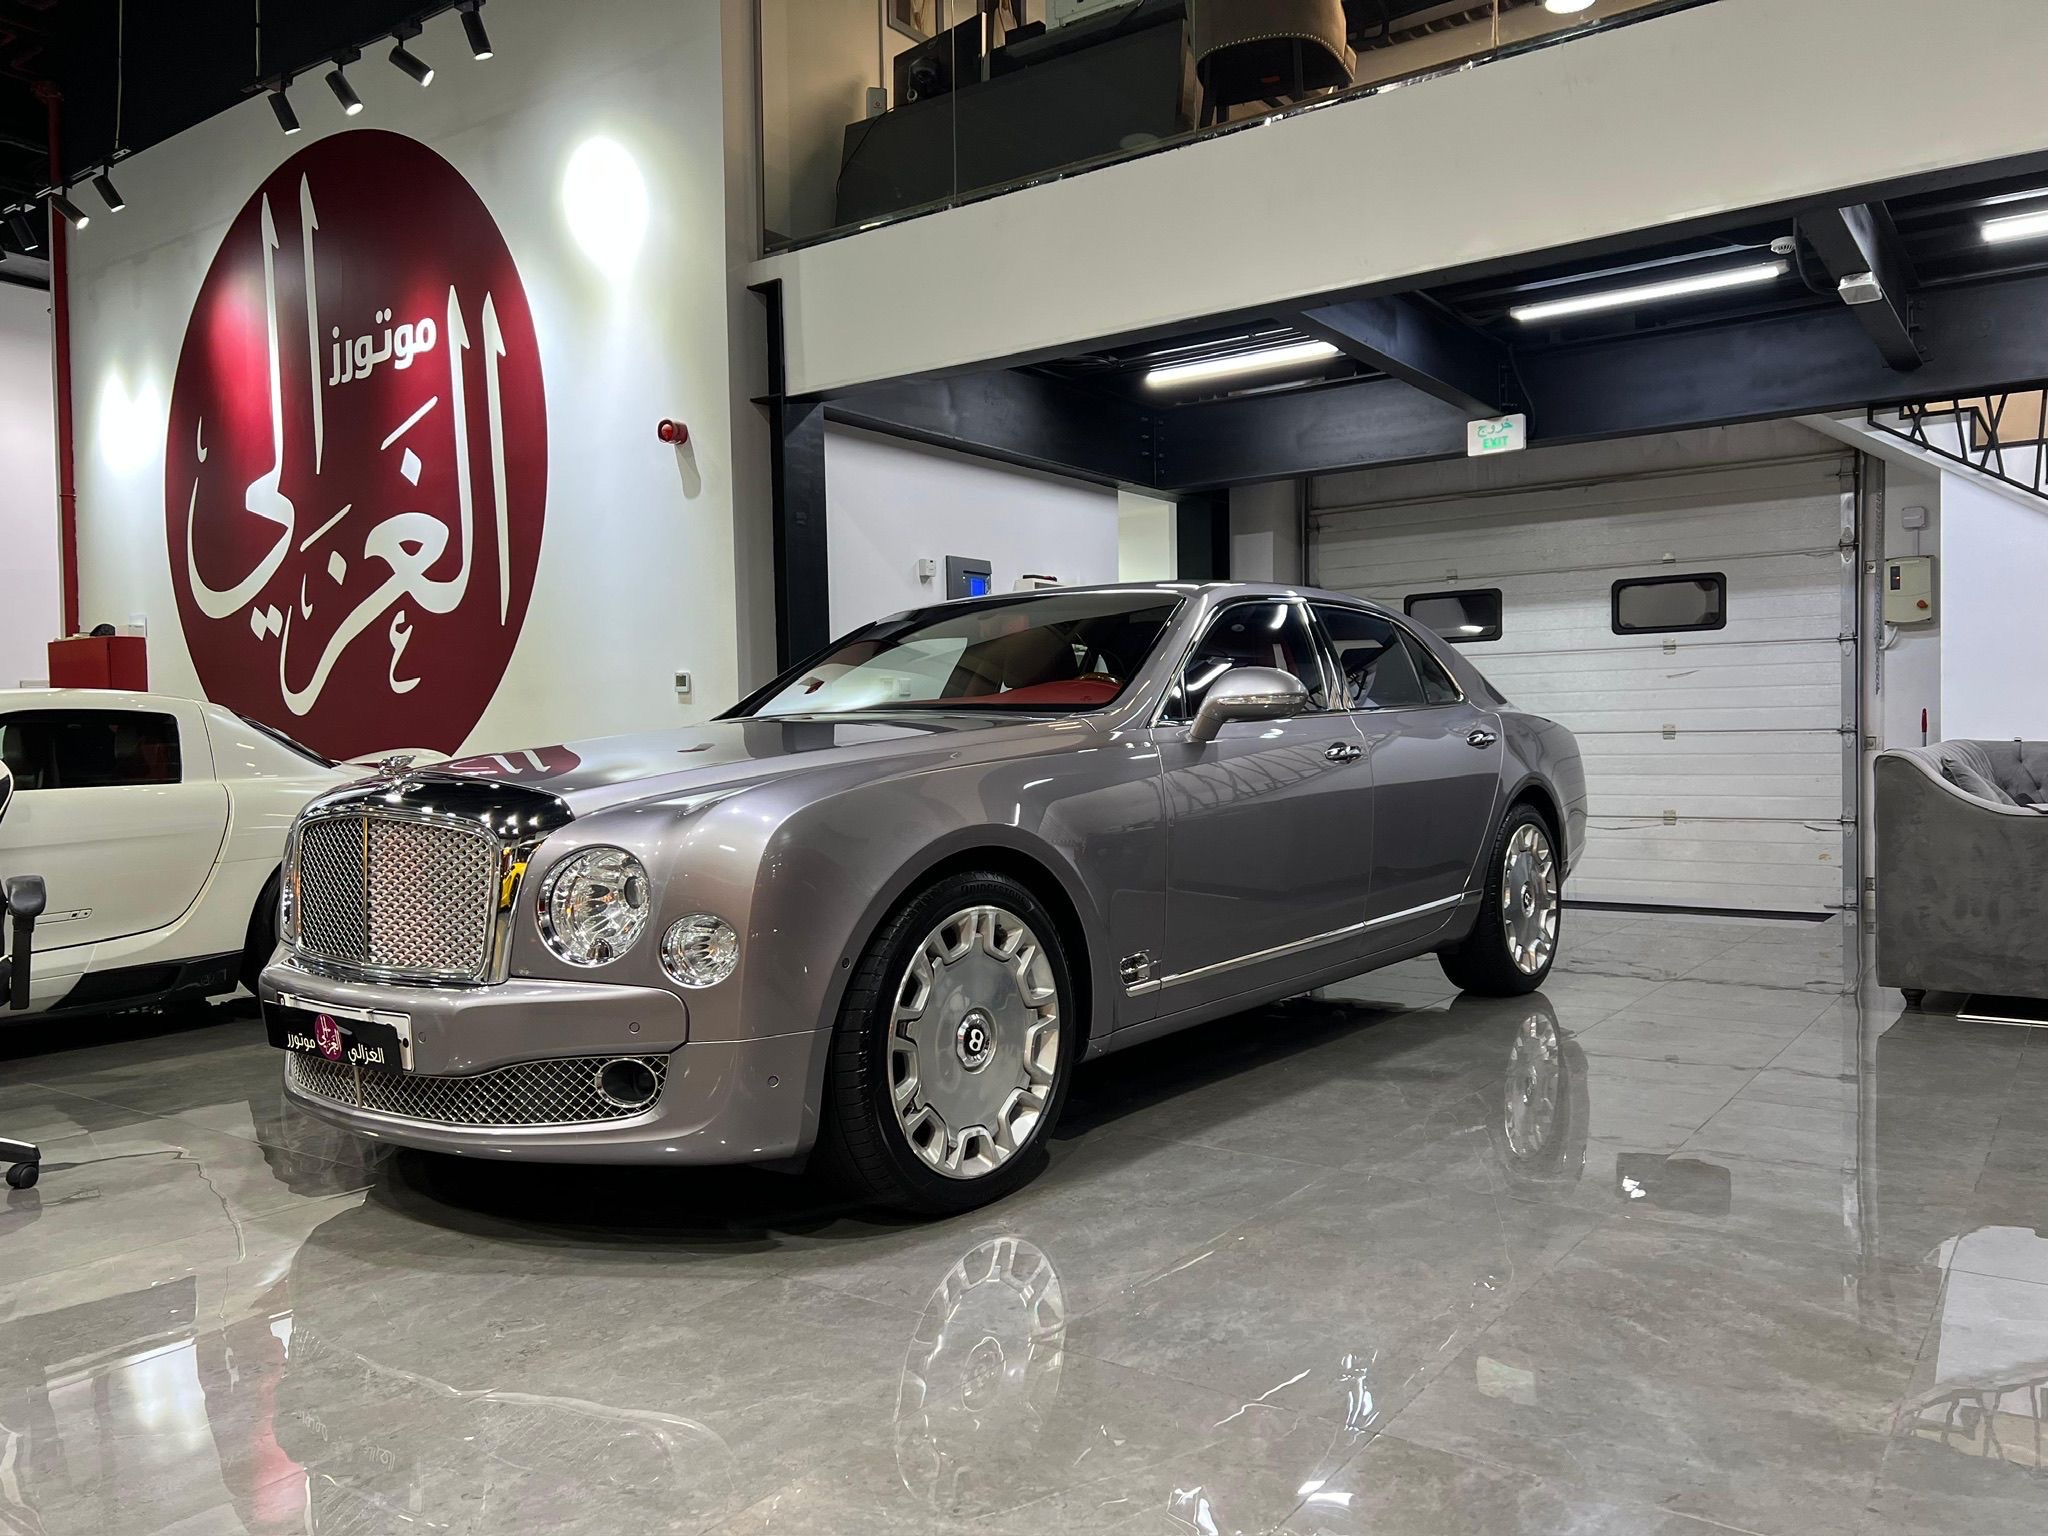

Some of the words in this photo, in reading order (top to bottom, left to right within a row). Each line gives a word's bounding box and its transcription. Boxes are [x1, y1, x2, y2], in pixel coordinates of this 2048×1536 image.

[329, 308, 437, 386] موتورز
[1477, 418, 1513, 438] خروج
[1483, 435, 1509, 449] EXIT
[347, 1043, 385, 1066] الغزالي
